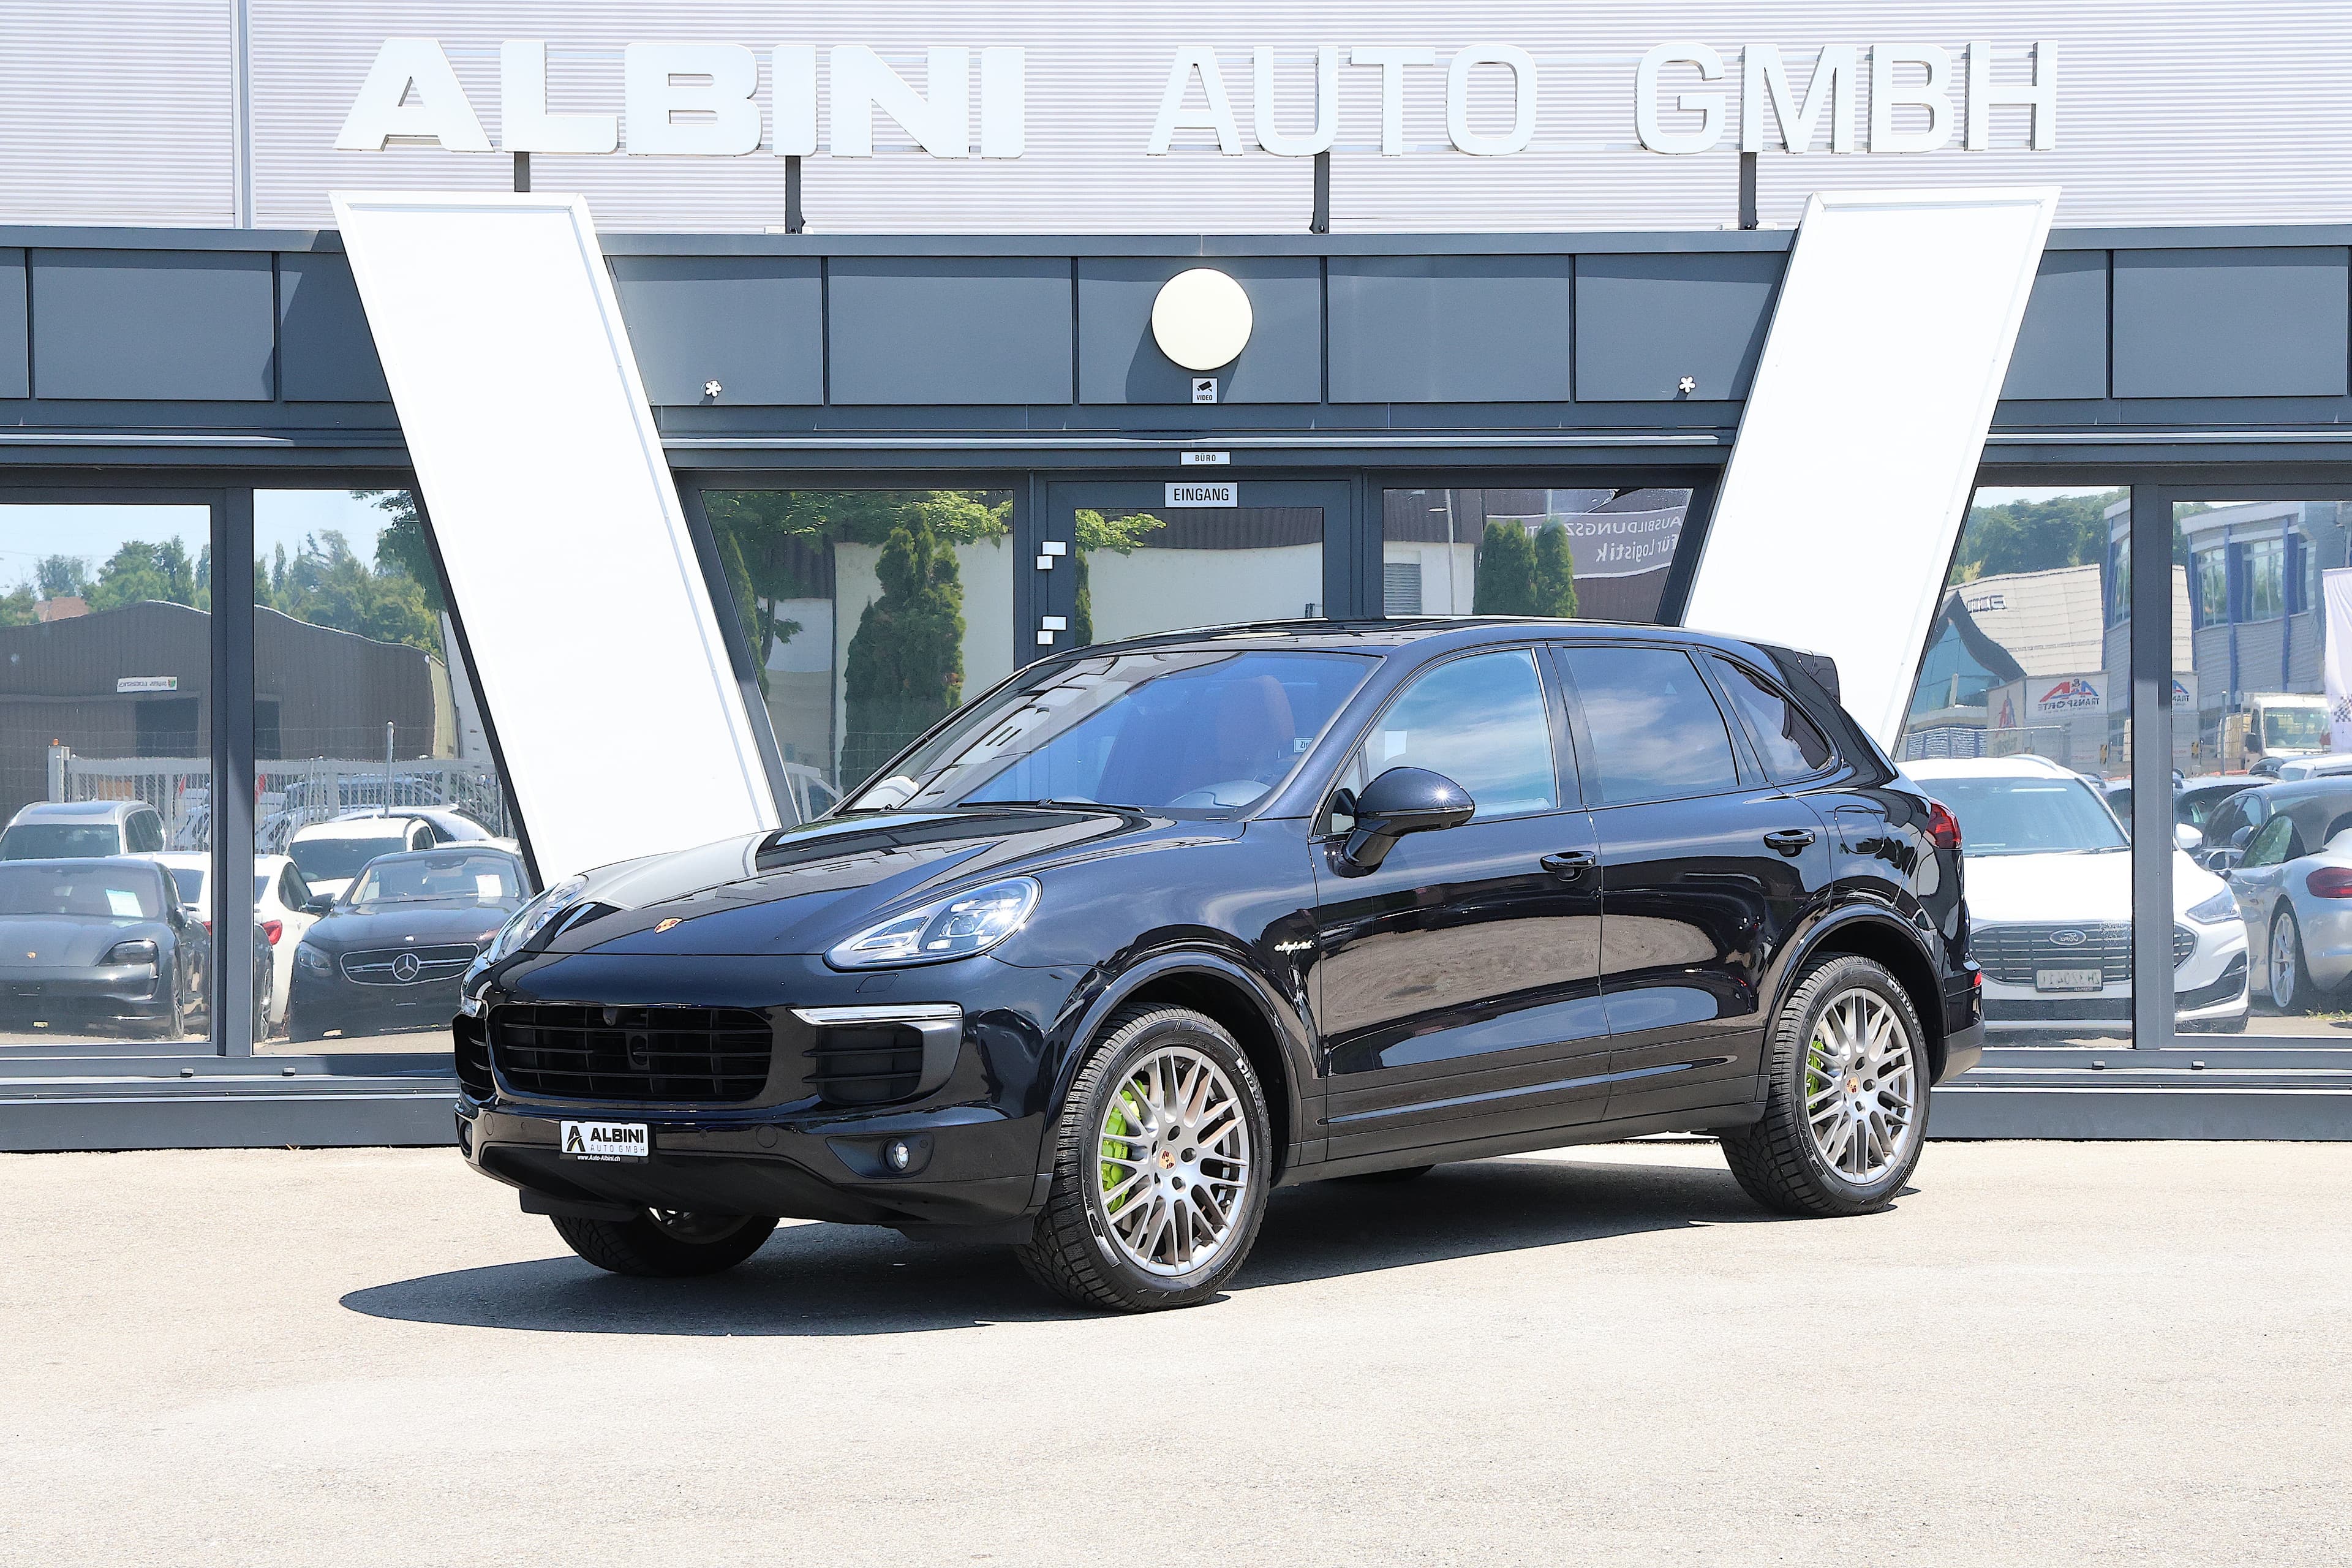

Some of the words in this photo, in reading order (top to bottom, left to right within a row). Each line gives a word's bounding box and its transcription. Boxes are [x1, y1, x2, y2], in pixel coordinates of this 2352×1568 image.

[333, 37, 1025, 159] ALBINI
[1147, 43, 1537, 156] AUTO
[1634, 40, 2058, 155] GMBH
[1195, 453, 1216, 462] BÜRO
[1174, 488, 1229, 501] EINGANG
[590, 1128, 644, 1144] ALBINI
[619, 1145, 645, 1153] GMBH
